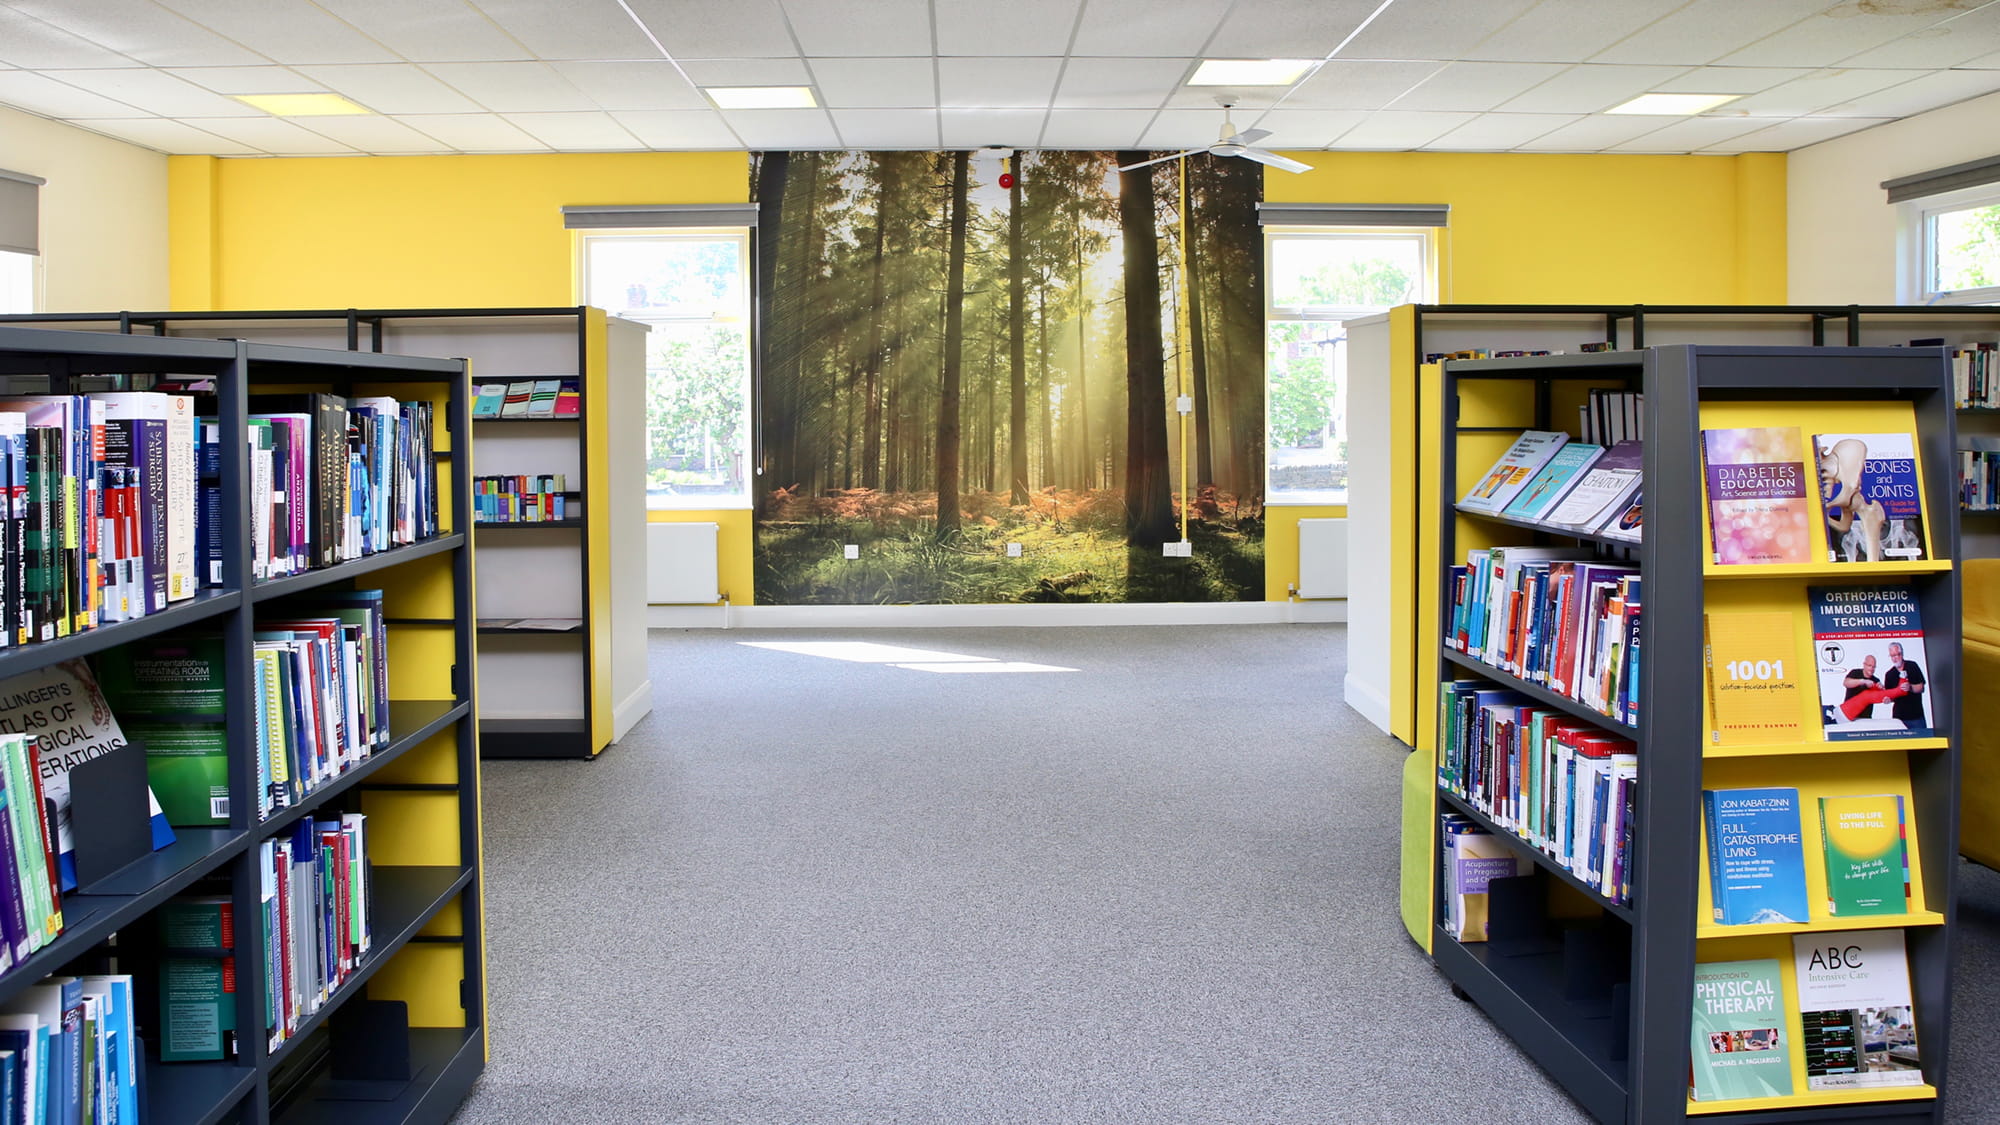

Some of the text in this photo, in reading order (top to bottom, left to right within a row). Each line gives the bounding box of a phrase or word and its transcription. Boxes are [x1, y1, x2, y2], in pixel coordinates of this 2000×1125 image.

[1718, 466, 1796, 480] DIABETES
[1864, 460, 1911, 474] BONES
[1720, 478, 1796, 490] EDUCATION
[1876, 475, 1893, 484] and
[1867, 484, 1914, 498] JOINTS
[155, 431, 165, 567] SABISTON TEXTBOOK
[59, 531, 63, 541] IN
[1825, 591, 1909, 603] ORTHOPAEDIC
[1820, 603, 1915, 615] IMMOBILIZATION
[1832, 616, 1908, 628] TECHNIQUES
[330, 631, 339, 681] WARD'S
[377, 660, 384, 668] in
[1726, 659, 1784, 681] 1001
[181, 667, 210, 675] ROOM
[1720, 682, 1795, 693] solution-focused questions
[51, 702, 76, 722] OF
[38, 724, 94, 754] GICAL
[40, 738, 121, 779] ERATIONS
[1721, 798, 1790, 809] JON KABAT-ZINN
[1722, 824, 1748, 834] FULL
[44, 818, 52, 854] SURGERY
[1723, 833, 1799, 846] CATASTROPHE
[1724, 847, 1757, 858] LIVING
[1465, 860, 1510, 868] Acupuncture
[1850, 864, 1861, 872] Key
[1872, 859, 1883, 867] skills
[1474, 868, 1509, 876] Pregnancy
[1851, 872, 1867, 880] change
[1868, 870, 1880, 879] your
[1465, 876, 1479, 884] and
[1808, 945, 1863, 971] ABC
[1696, 973, 1740, 981] INTRODUCTION
[1808, 971, 1870, 982] Intensive Care
[1696, 979, 1775, 999] PHYSICAL
[1705, 996, 1774, 1015] THERAPY
[1745, 1056, 1781, 1065] PAGLIARULO
